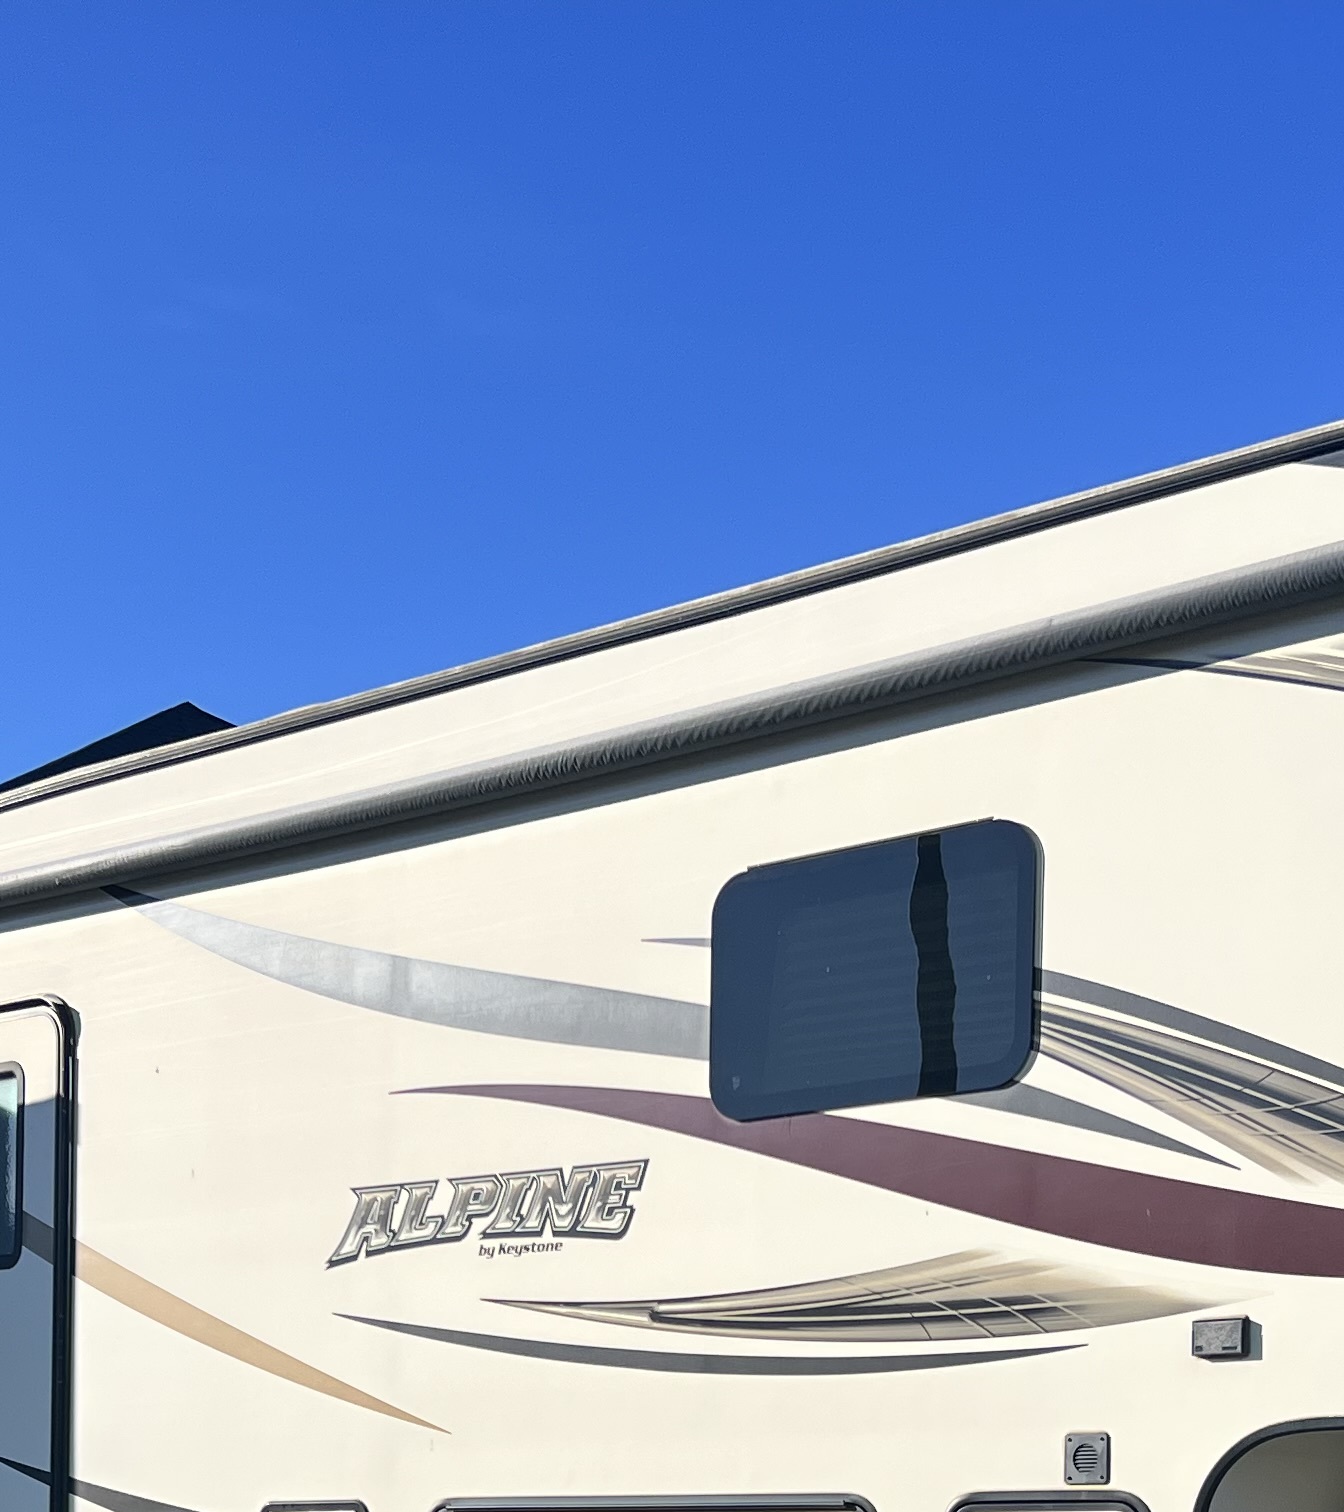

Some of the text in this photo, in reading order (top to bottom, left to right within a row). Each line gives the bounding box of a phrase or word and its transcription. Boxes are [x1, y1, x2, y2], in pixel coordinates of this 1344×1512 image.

[324, 1158, 650, 1271] ALPINE
[478, 1241, 564, 1259] by Keystone
